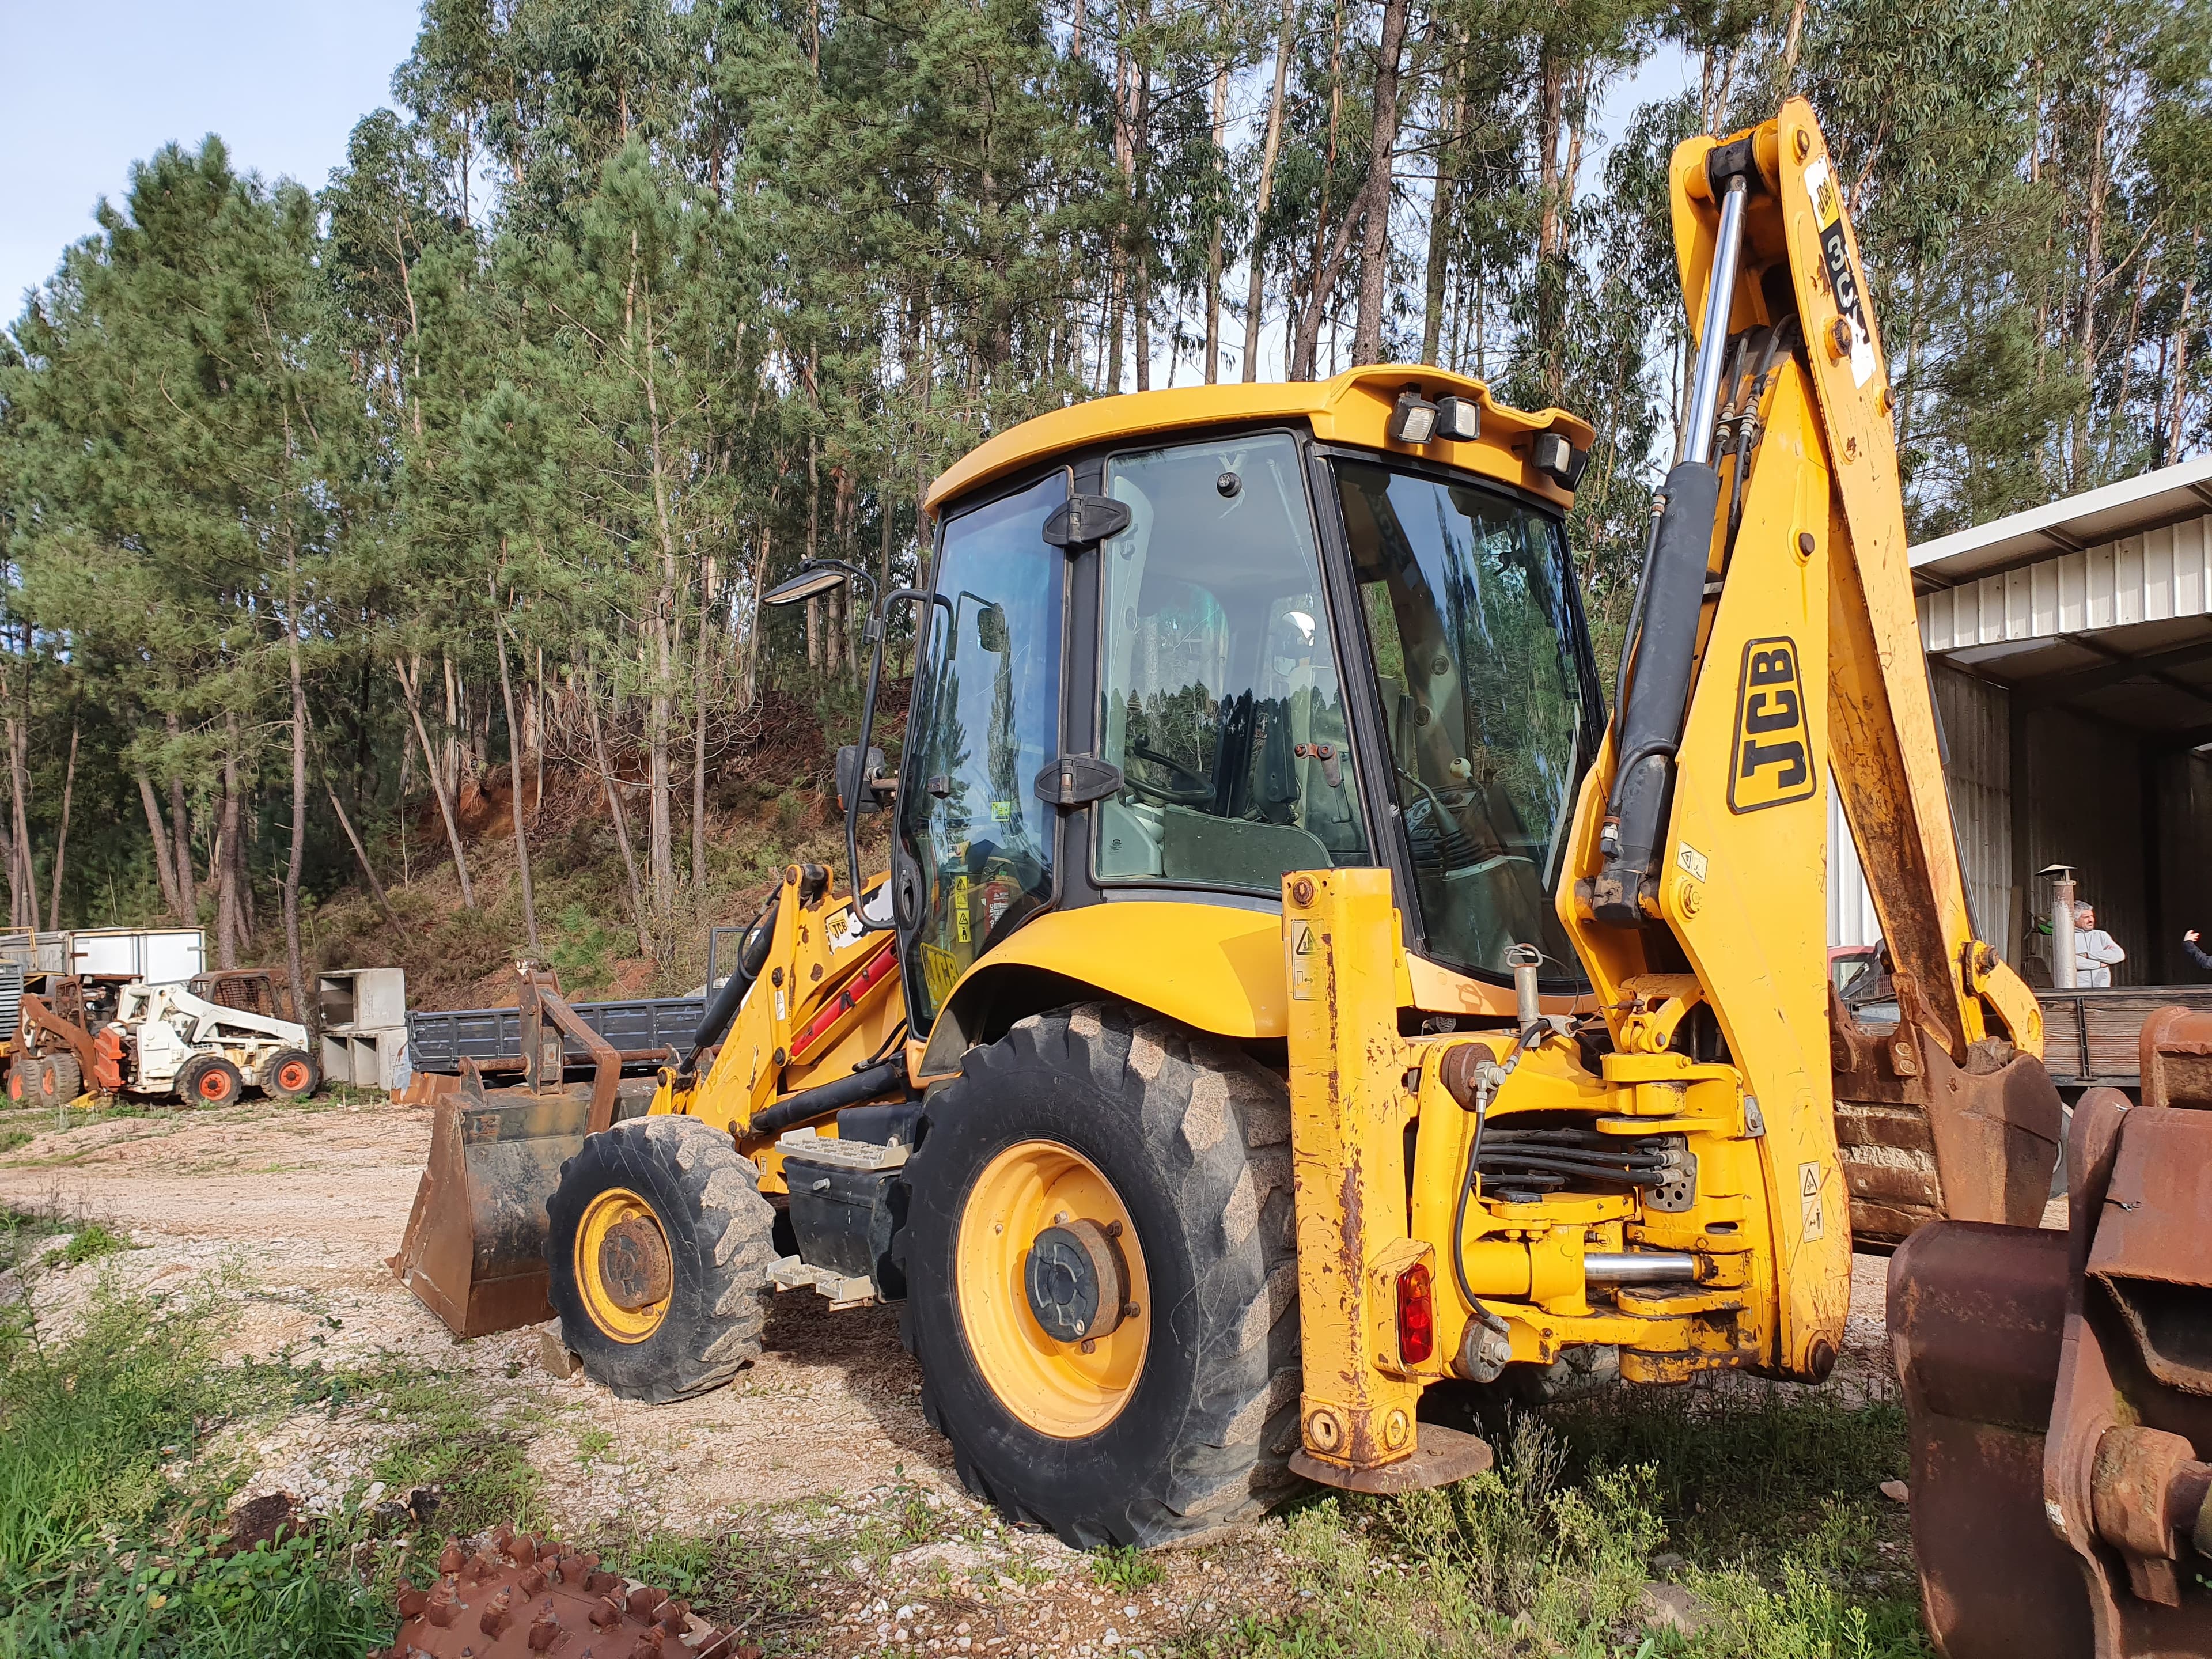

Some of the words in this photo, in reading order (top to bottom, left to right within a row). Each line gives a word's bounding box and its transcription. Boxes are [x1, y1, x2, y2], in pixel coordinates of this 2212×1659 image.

[1817, 180, 1831, 215] JCB
[1827, 234, 1858, 324] 3C
[1741, 649, 1806, 789] JCB
[832, 921, 848, 940] JCB
